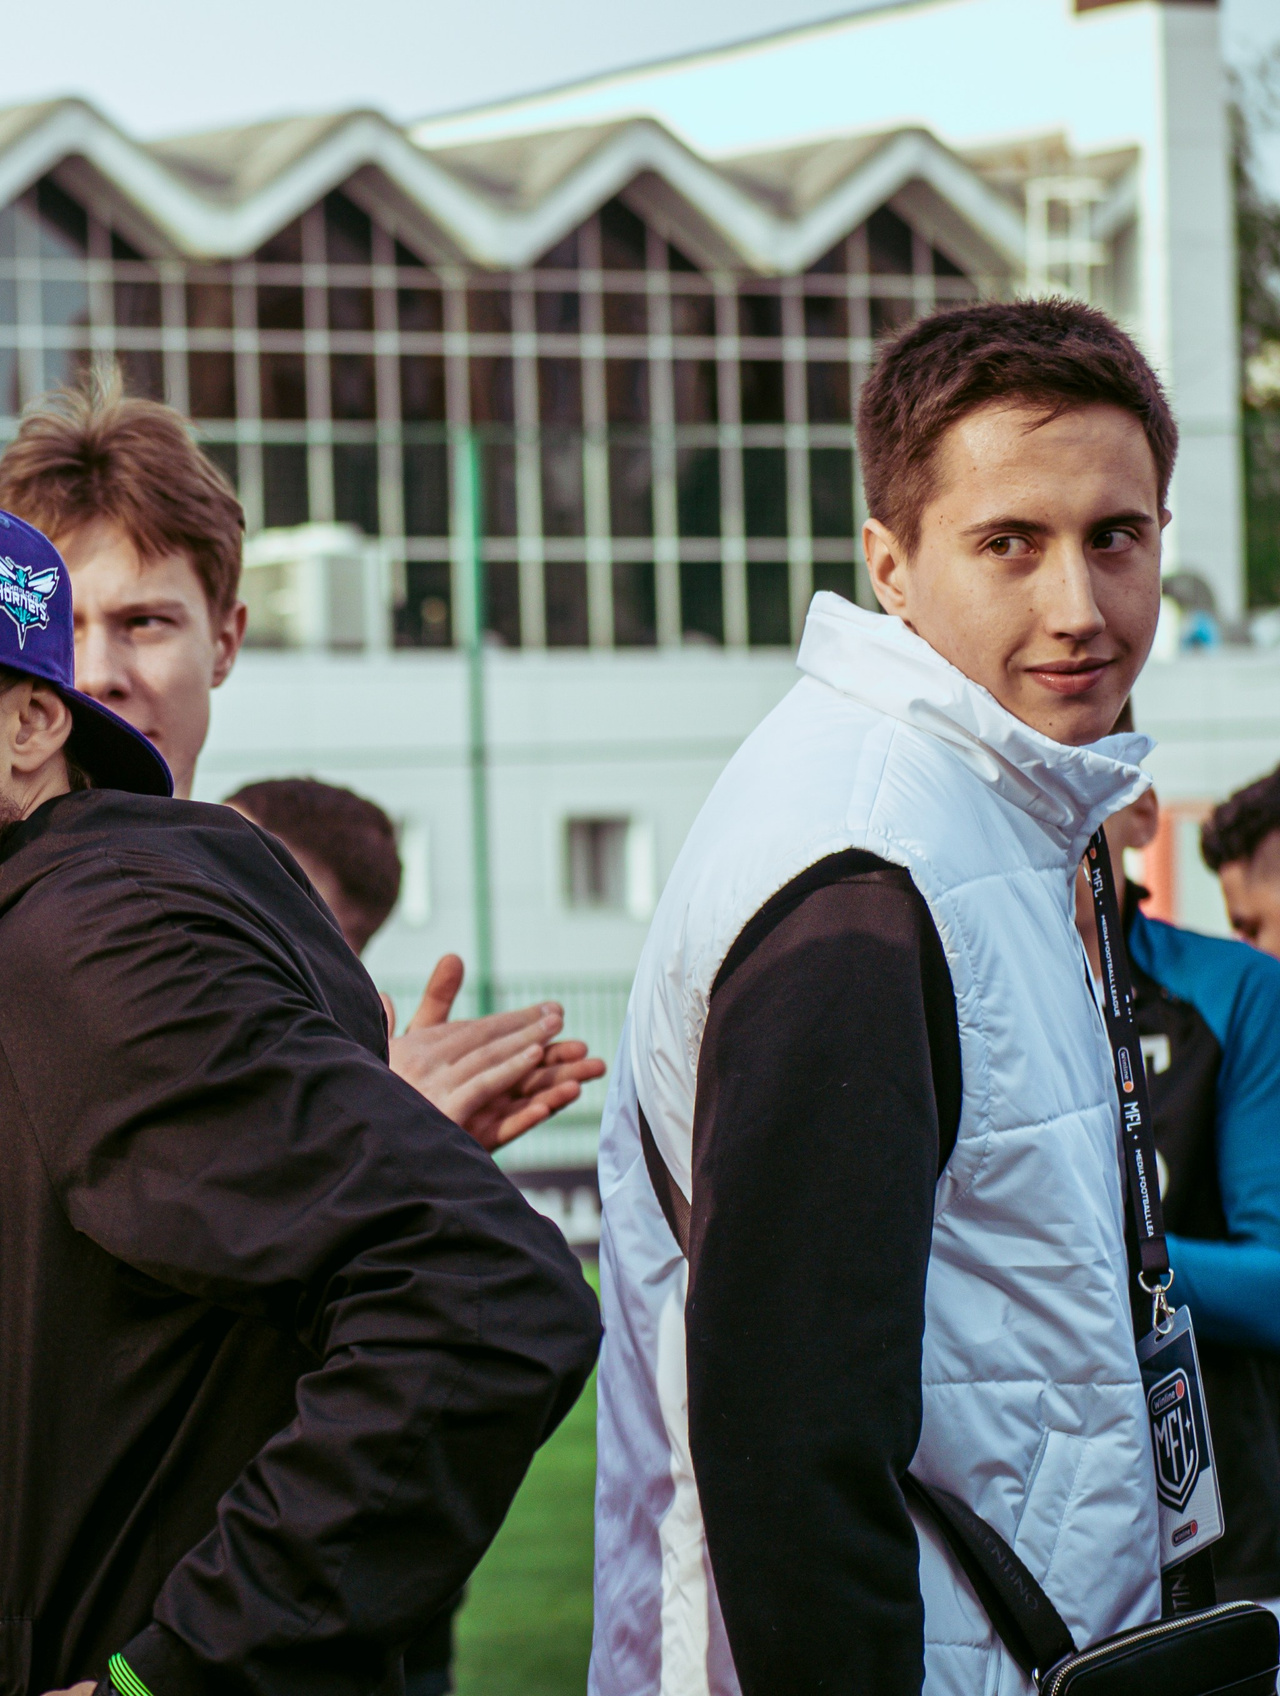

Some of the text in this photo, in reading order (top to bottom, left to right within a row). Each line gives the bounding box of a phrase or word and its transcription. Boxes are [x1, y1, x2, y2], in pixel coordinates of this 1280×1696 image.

[1092, 867, 1121, 1018] MFL MEDIA FOOTBALL LEAGUE
[1123, 1101, 1142, 1132] MFL
[1135, 1149, 1145, 1176] MEDIA
[1139, 1175, 1151, 1220] FOOTBALL
[1153, 1406, 1194, 1488] MFL
